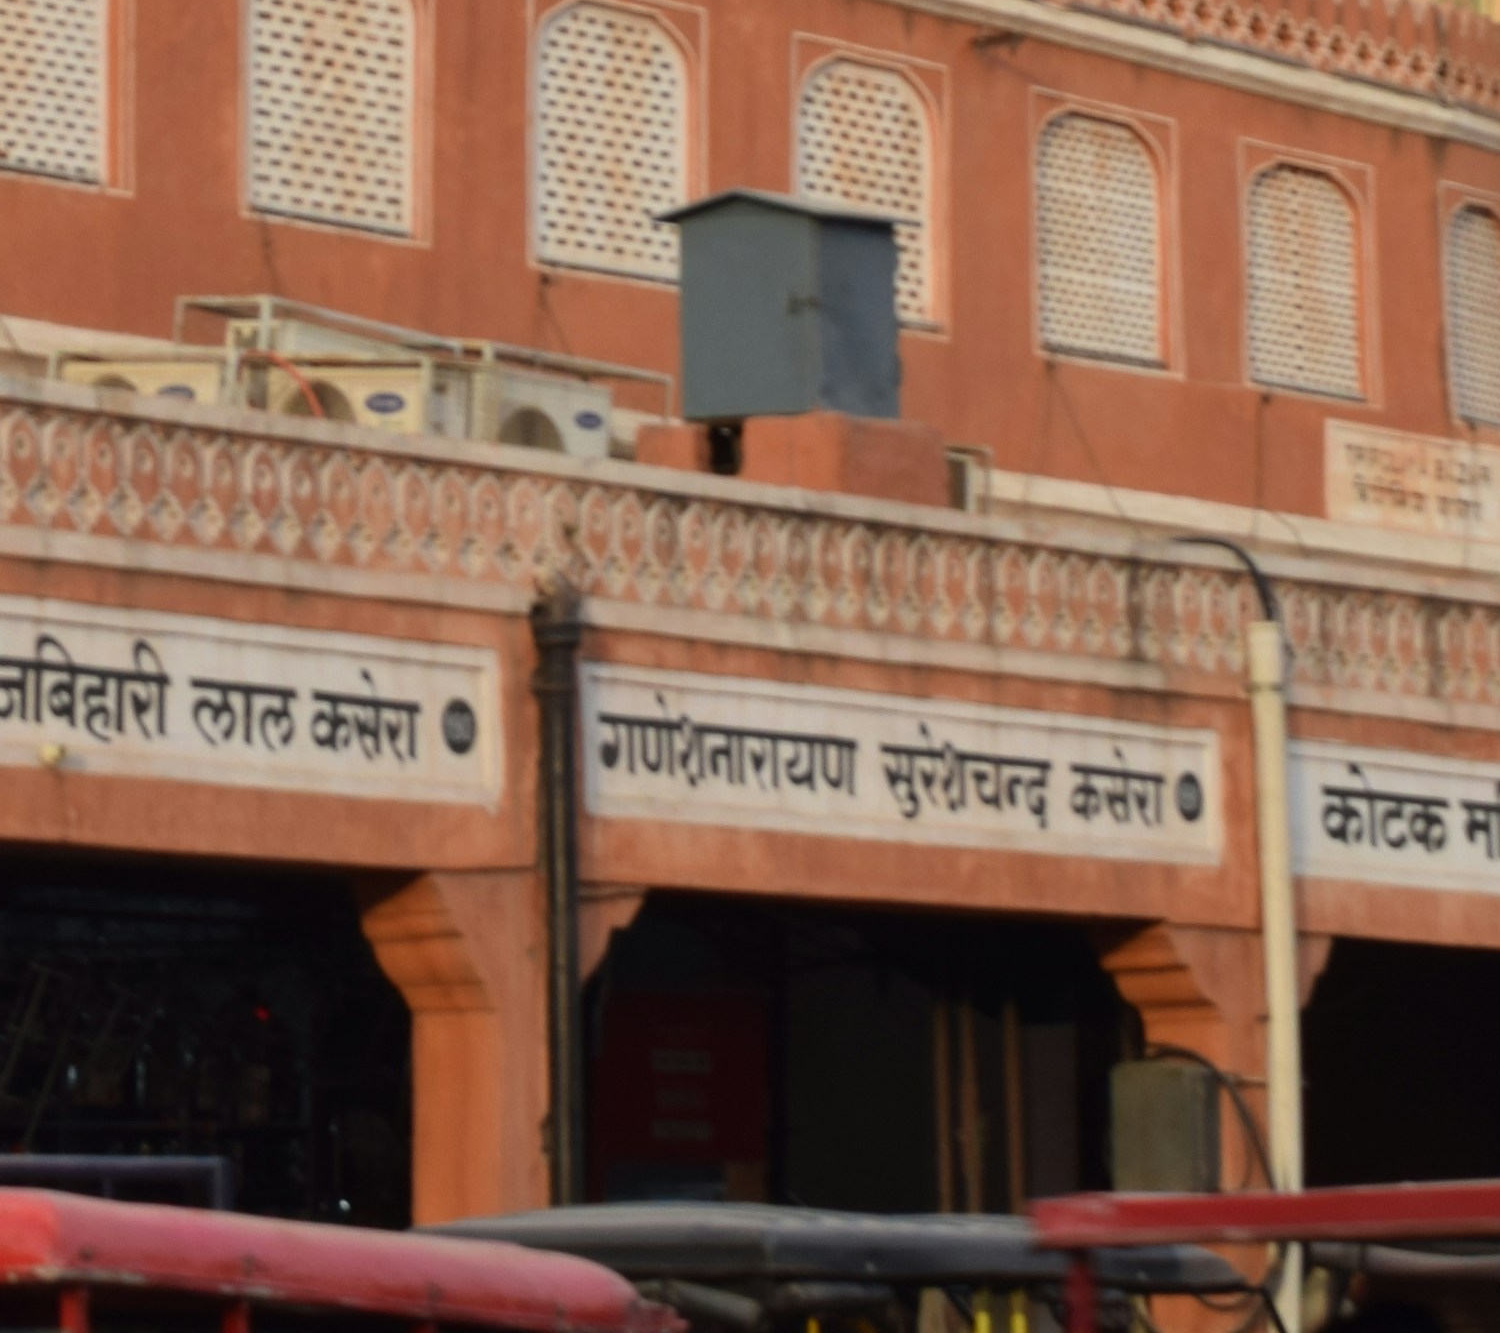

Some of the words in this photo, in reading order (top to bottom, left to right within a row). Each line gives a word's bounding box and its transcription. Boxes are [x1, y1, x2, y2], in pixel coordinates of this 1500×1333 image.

[190, 678, 298, 749] लाल
[312, 670, 421, 761] कसेरा
[1070, 749, 1166, 825] कसेरा
[1322, 762, 1450, 852] कोटक
